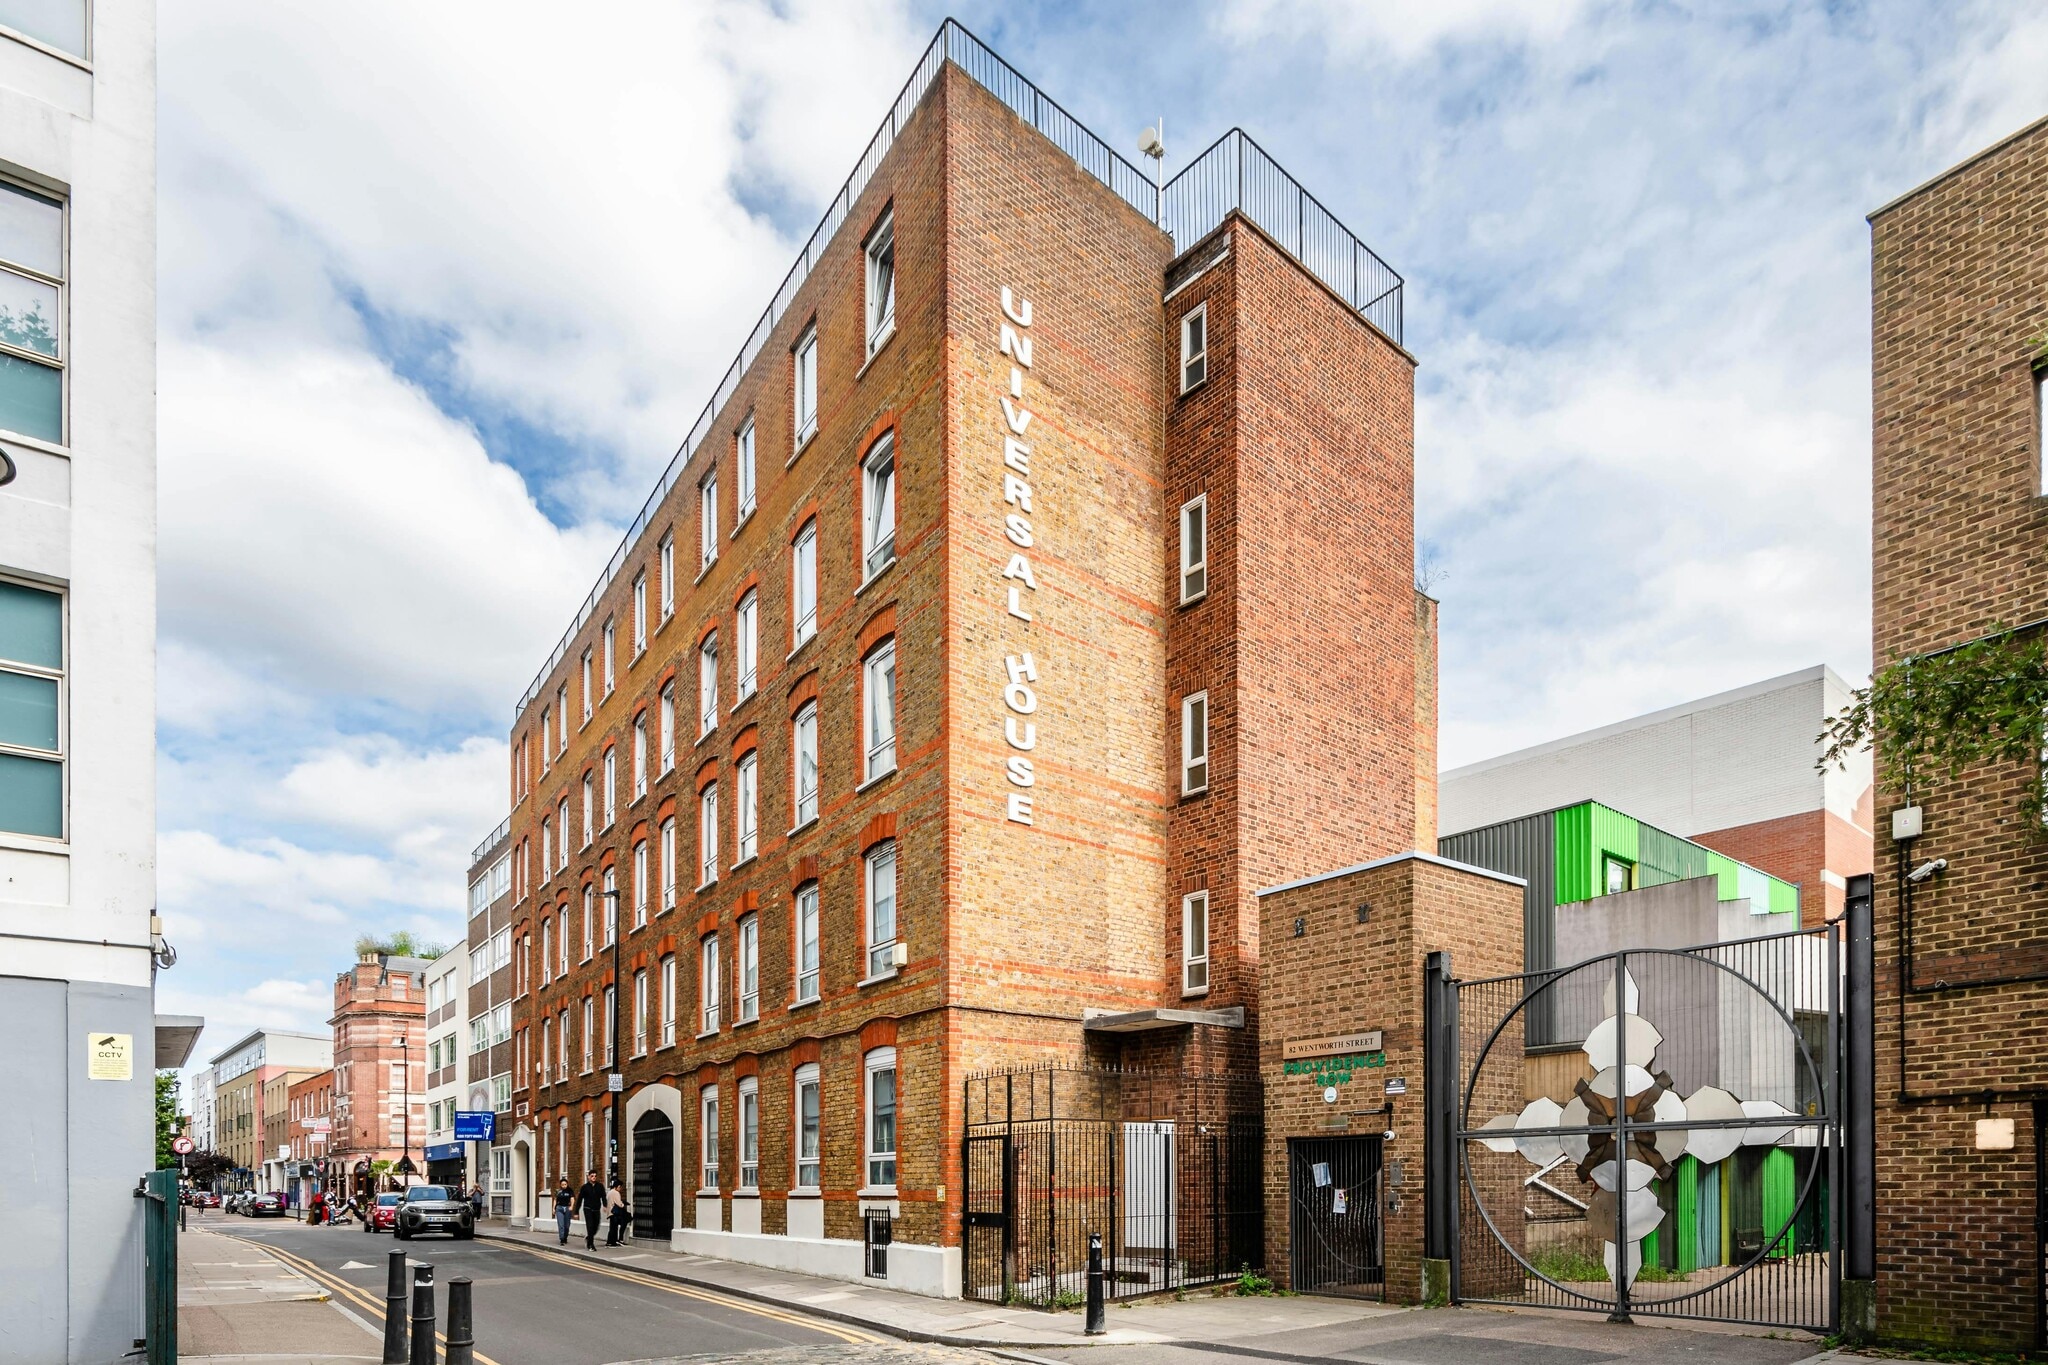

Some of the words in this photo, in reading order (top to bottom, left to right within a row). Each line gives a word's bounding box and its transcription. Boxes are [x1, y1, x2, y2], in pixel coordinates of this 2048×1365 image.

[1000, 284, 1037, 623] UNIVERSAL
[1003, 652, 1038, 826] HOUSE
[1288, 1046, 1297, 1054] 82
[1298, 1041, 1344, 1053] WENTWORTH
[1346, 1037, 1374, 1048] STREET
[1283, 1053, 1386, 1076] PROVIDENCE
[1317, 1071, 1352, 1087] ROW
